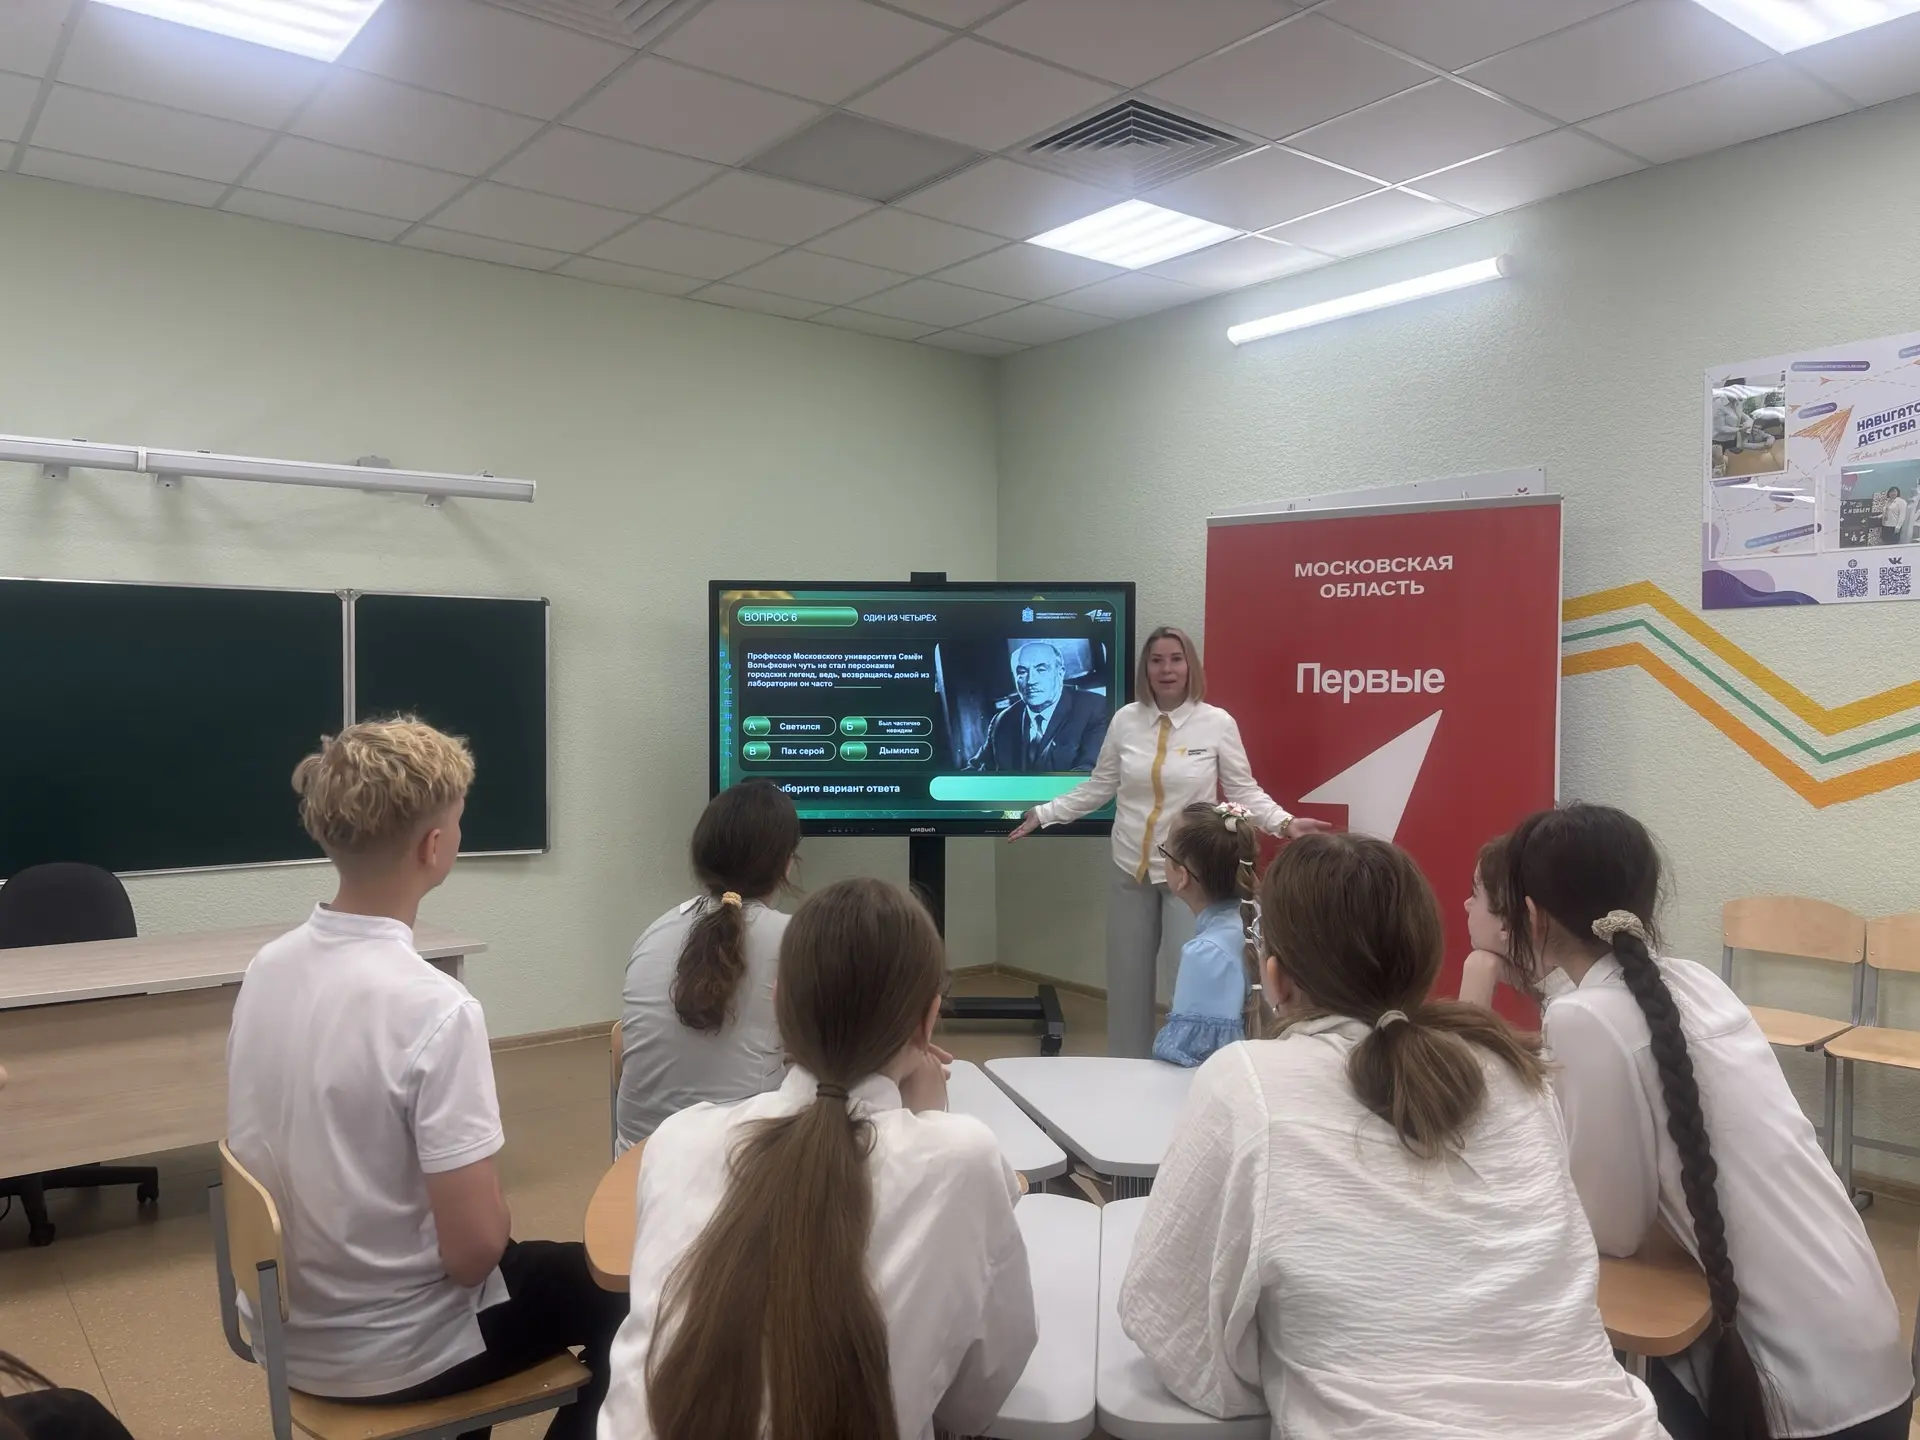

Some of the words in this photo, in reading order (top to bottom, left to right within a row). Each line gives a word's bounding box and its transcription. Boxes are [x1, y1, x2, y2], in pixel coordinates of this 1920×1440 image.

[1858, 419, 1916, 447] ДЕТСТВА
[1294, 555, 1453, 578] МОСКОВСКАЯ
[1319, 580, 1425, 599] ОБЛАСТЬ
[744, 612, 789, 622] ВОПРОС
[791, 612, 797, 622] 6
[863, 613, 885, 622] ОДИН
[887, 613, 898, 622] ИЗ
[900, 612, 937, 622] ЧЕТЫРЁХ
[747, 652, 791, 661] Профессор
[793, 652, 843, 660] Московского
[844, 653, 897, 661] университета
[898, 652, 923, 660] Семён
[747, 662, 796, 670] Вольфкович
[848, 662, 895, 670] персонажем
[747, 671, 787, 680] городских
[789, 672, 818, 680] легенд,
[819, 672, 840, 680] ведь,
[842, 671, 893, 680] возвращаясь
[894, 671, 919, 680] домой
[747, 680, 798, 689] лаборатории
[1296, 662, 1446, 704] Первые
[748, 722, 756, 731] А
[779, 722, 821, 731] Светился
[846, 722, 853, 731] Б
[749, 747, 756, 756] В
[781, 747, 797, 755] Пах
[798, 746, 825, 756] серой
[847, 747, 853, 756] Г
[879, 747, 920, 756] Дымился
[773, 783, 820, 795] ыберите
[822, 785, 864, 795] вариант
[866, 785, 900, 793] ответа
